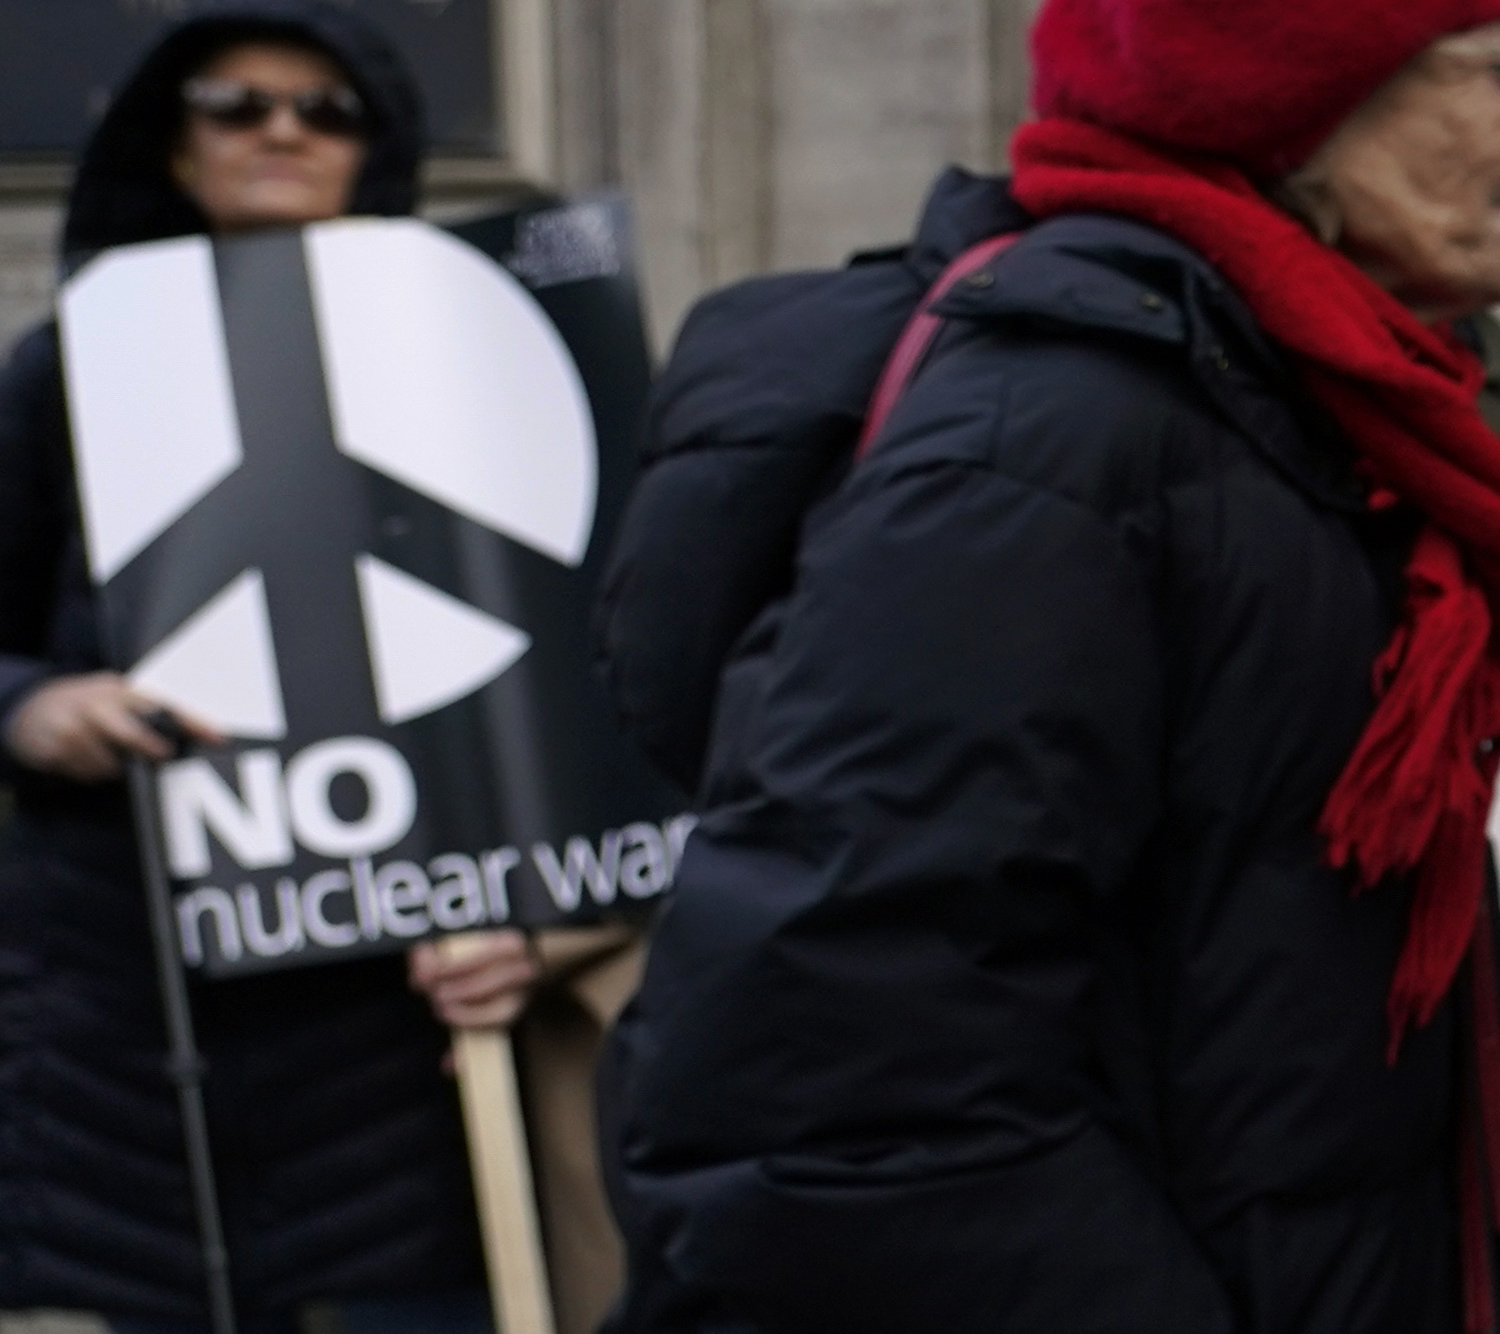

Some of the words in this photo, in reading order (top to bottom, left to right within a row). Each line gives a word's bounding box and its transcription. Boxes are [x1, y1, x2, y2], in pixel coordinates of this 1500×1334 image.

[156, 734, 418, 880] NO
[175, 850, 520, 968] nuclear
[528, 811, 700, 912] war
